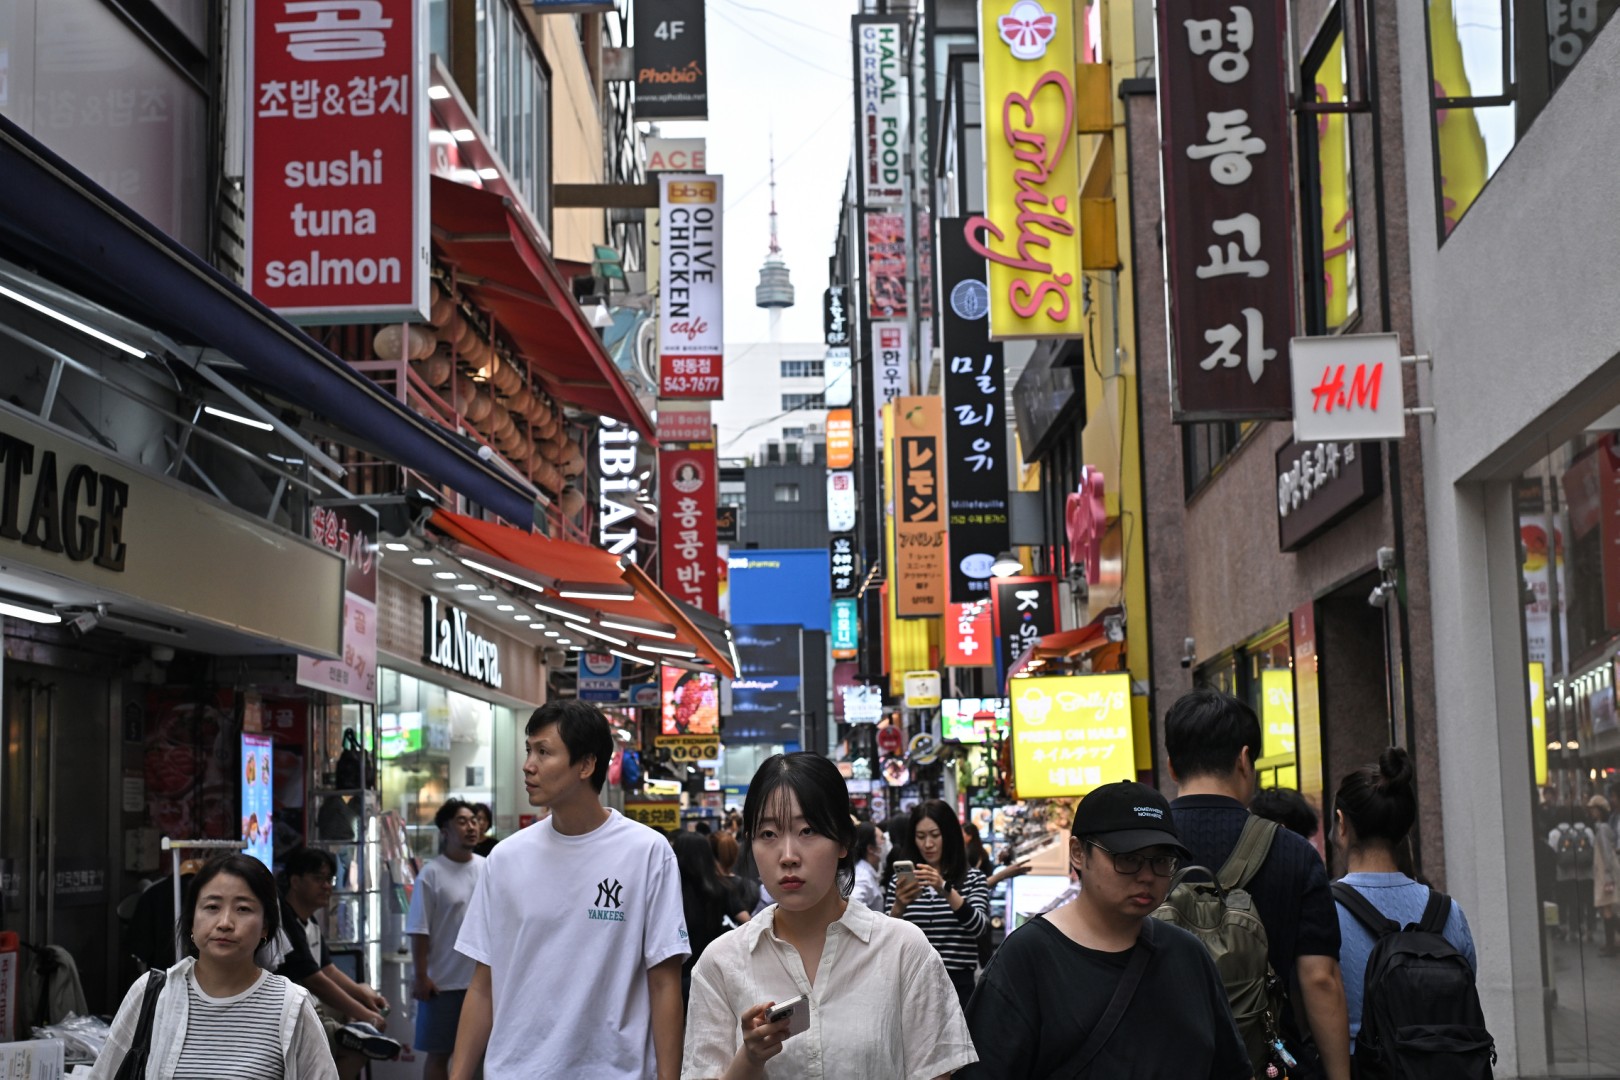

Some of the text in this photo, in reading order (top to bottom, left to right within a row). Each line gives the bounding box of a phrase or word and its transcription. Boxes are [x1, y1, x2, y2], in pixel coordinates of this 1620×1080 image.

[654, 20, 685, 41] 4F
[639, 64, 701, 84] Phobia
[863, 27, 878, 113] GURKHA
[879, 28, 896, 104] HALAL
[258, 74, 408, 119] 초밥&참치
[284, 149, 383, 188] sushi
[881, 117, 899, 185] FOOD
[671, 183, 714, 201] bbq
[964, 70, 1075, 322] Emily's
[1183, 5, 1277, 384] 명동교자
[291, 202, 376, 237] tuna
[669, 207, 690, 319] CHICKEN
[693, 207, 716, 284] OLIVE
[265, 250, 401, 288] salmon
[670, 316, 708, 341] cafe
[1311, 362, 1384, 414] H&M
[906, 440, 937, 522] レモン
[672, 496, 706, 610] 홍콩반
[1065, 728, 1085, 741] ON
[588, 908, 626, 921] YANKEES
[594, 877, 623, 909] NY
